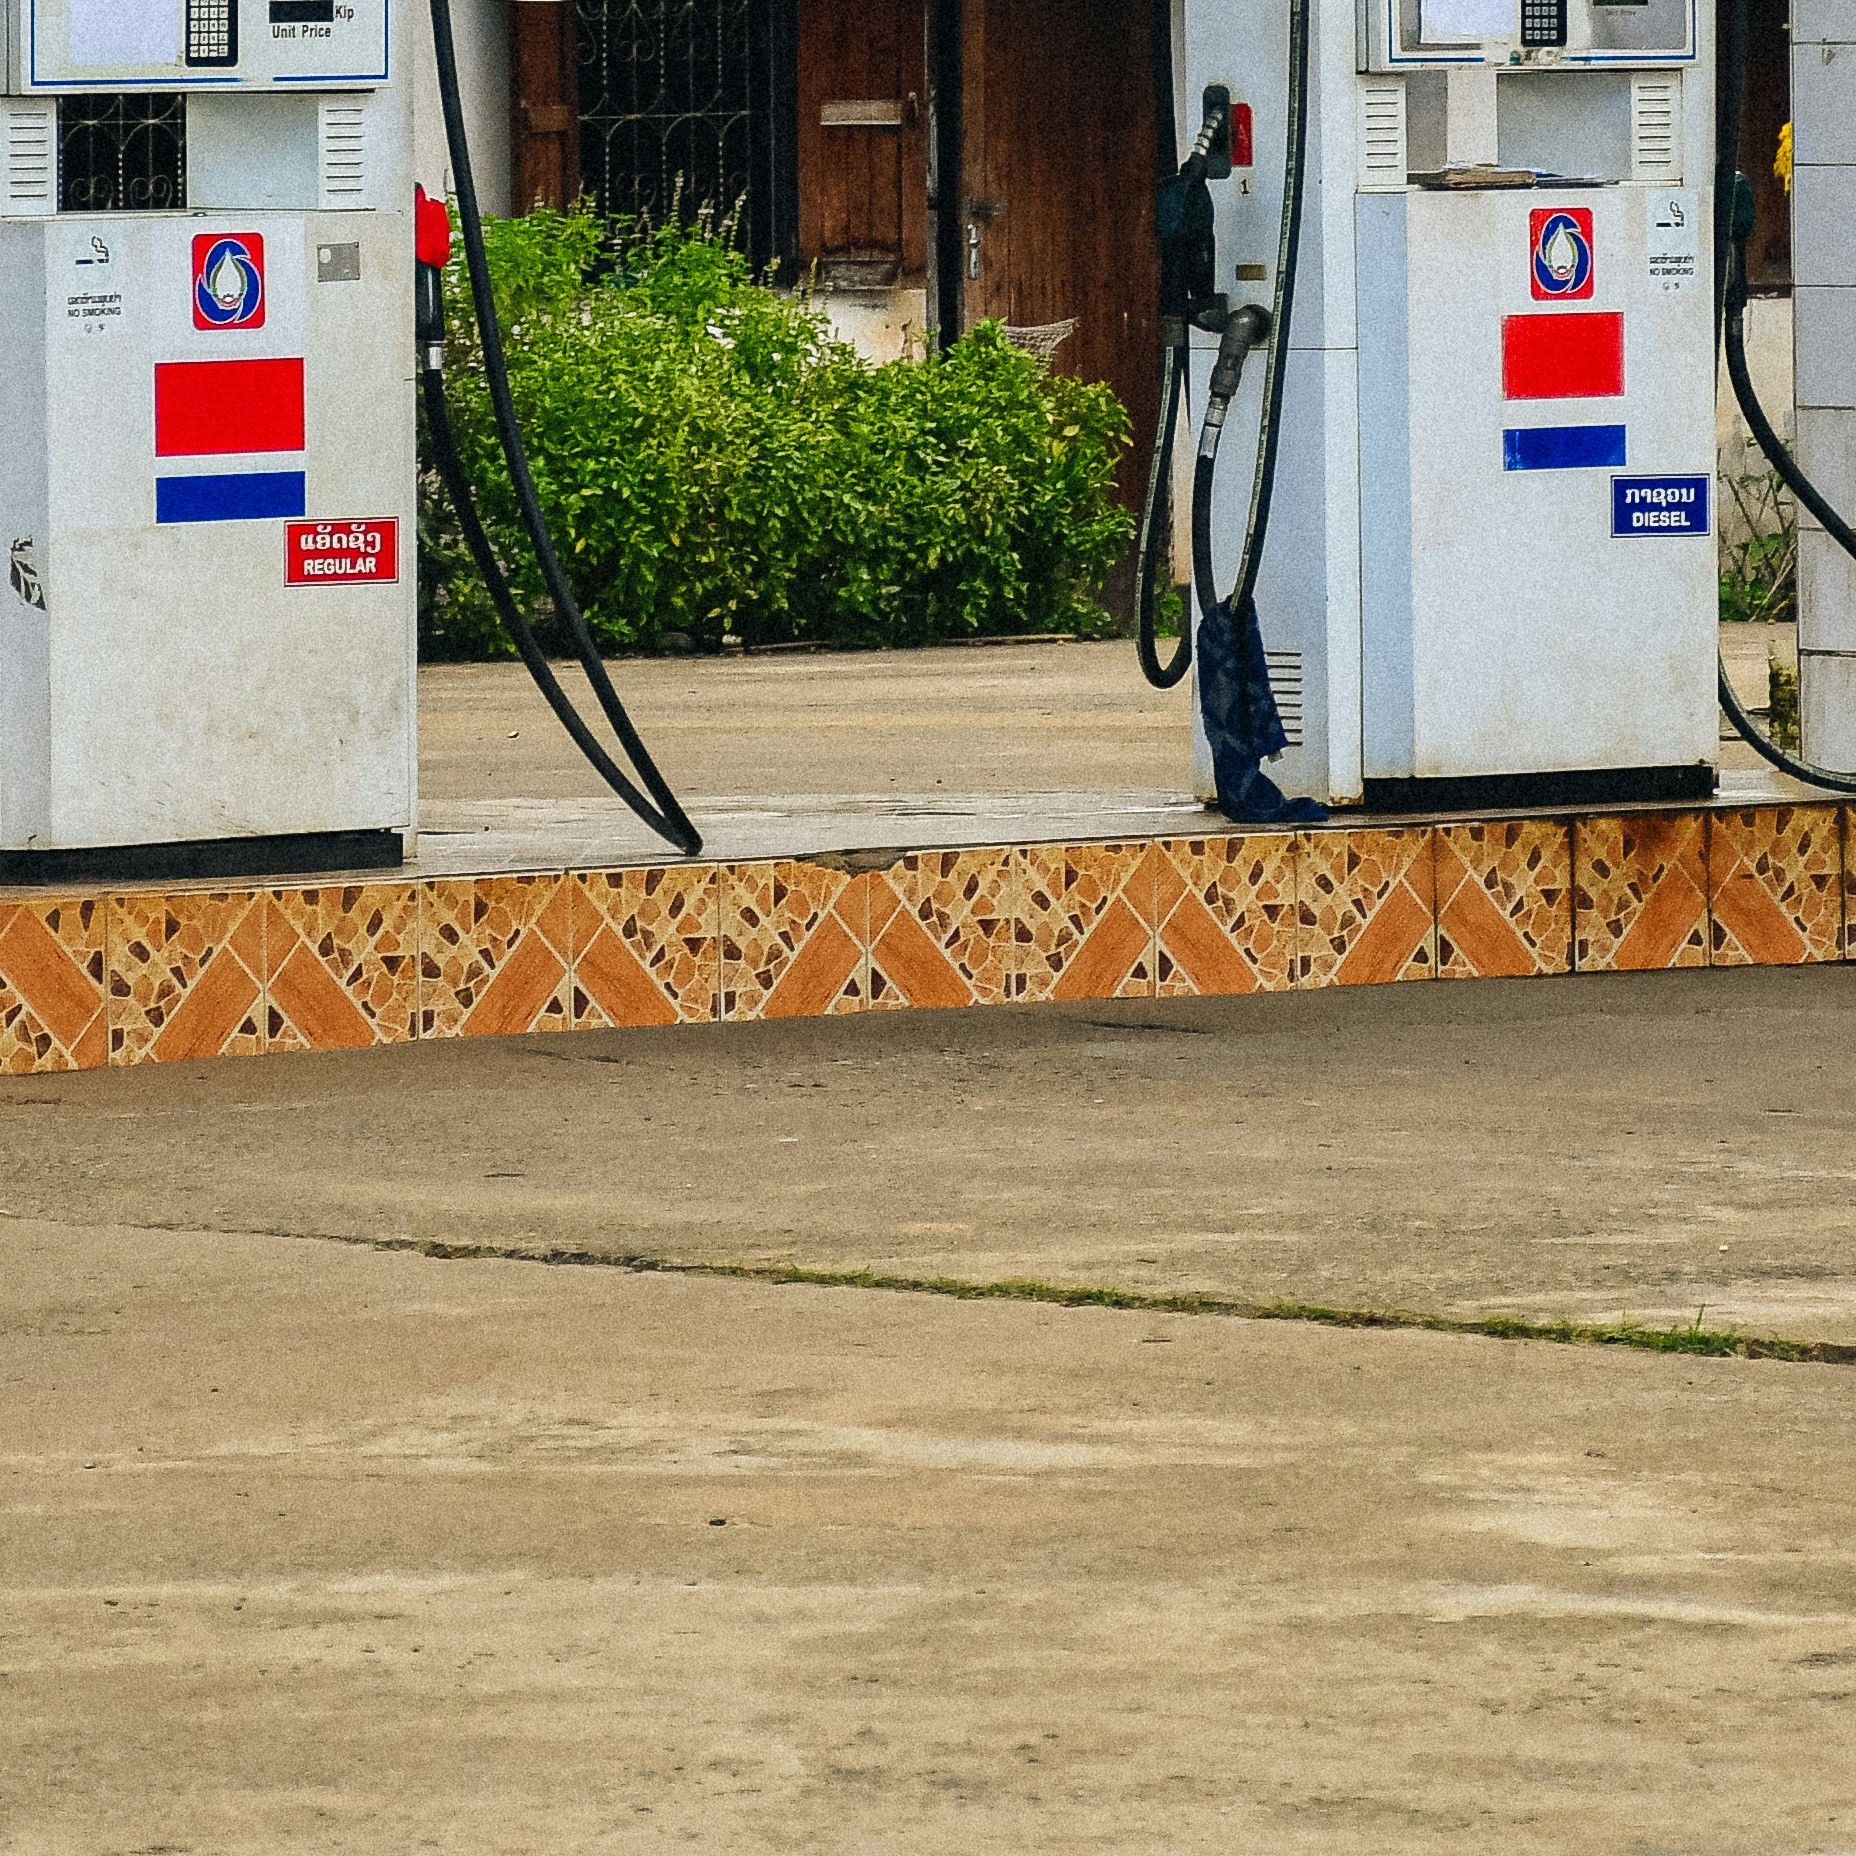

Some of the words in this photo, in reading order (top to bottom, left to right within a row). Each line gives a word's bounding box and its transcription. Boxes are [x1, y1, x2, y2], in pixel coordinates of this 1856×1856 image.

[335, 5, 354, 21] Kip
[272, 25, 296, 39] Unit
[301, 24, 331, 38] Price
[1241, 178, 1250, 195] 1
[1632, 511, 1691, 527] DIESEL
[303, 557, 377, 575] REGULAR
